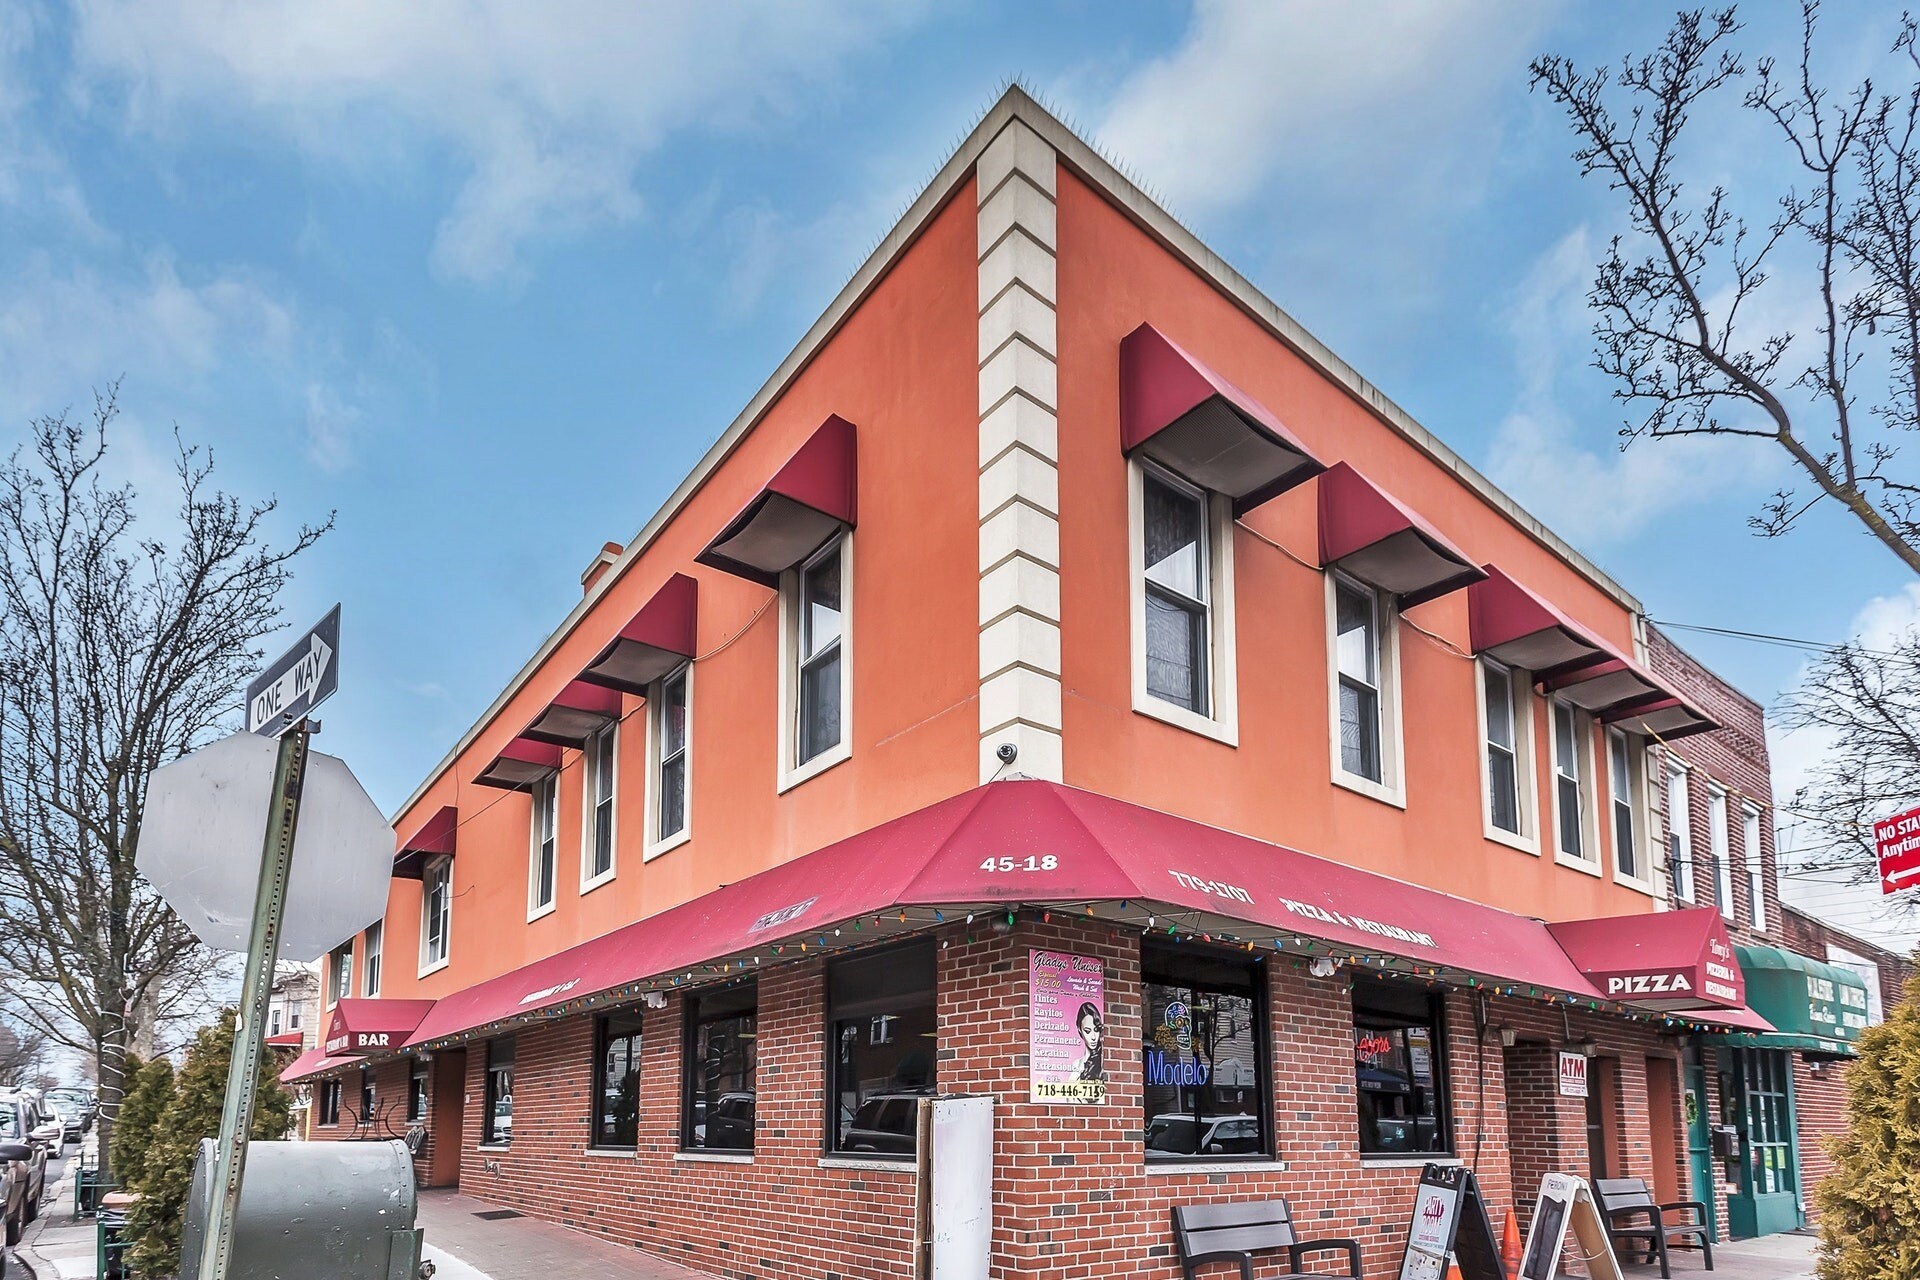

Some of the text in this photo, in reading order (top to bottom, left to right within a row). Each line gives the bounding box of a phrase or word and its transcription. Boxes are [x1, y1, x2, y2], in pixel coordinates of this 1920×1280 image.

[257, 645, 323, 724] ONE WAY
[1878, 815, 1920, 842] NO STA
[979, 854, 1058, 872] 45-18
[1168, 869, 1256, 905] 779-1707
[1278, 896, 1339, 924] PIZZA
[1034, 951, 1103, 973] Gladys Unisex
[1608, 974, 1692, 994] PIZZA
[1034, 994, 1058, 1004] Tintes
[1034, 1007, 1063, 1018] Rayitos
[358, 1033, 389, 1046] BAR
[1034, 1035, 1081, 1046] Permanente
[1034, 1048, 1069, 1058] Keratina
[1147, 1050, 1209, 1086] Modelo
[1561, 1057, 1585, 1078] ATM
